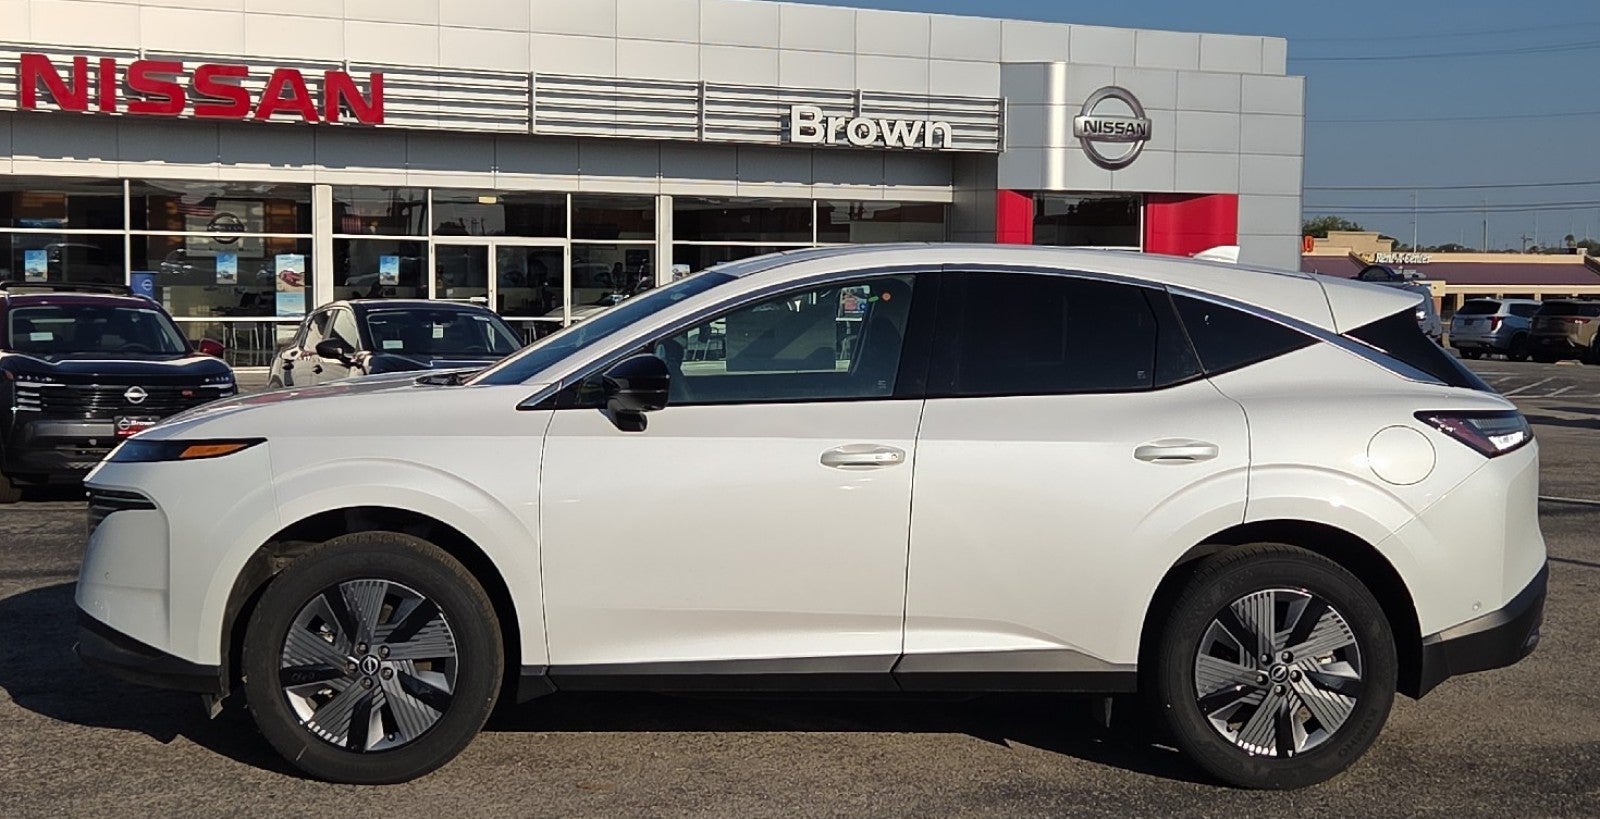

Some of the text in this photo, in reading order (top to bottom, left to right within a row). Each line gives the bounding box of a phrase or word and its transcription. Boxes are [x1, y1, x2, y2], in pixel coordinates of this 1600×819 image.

[19, 53, 384, 125] NISSAN
[790, 105, 952, 148] Brown
[1083, 120, 1146, 136] NISSAN
